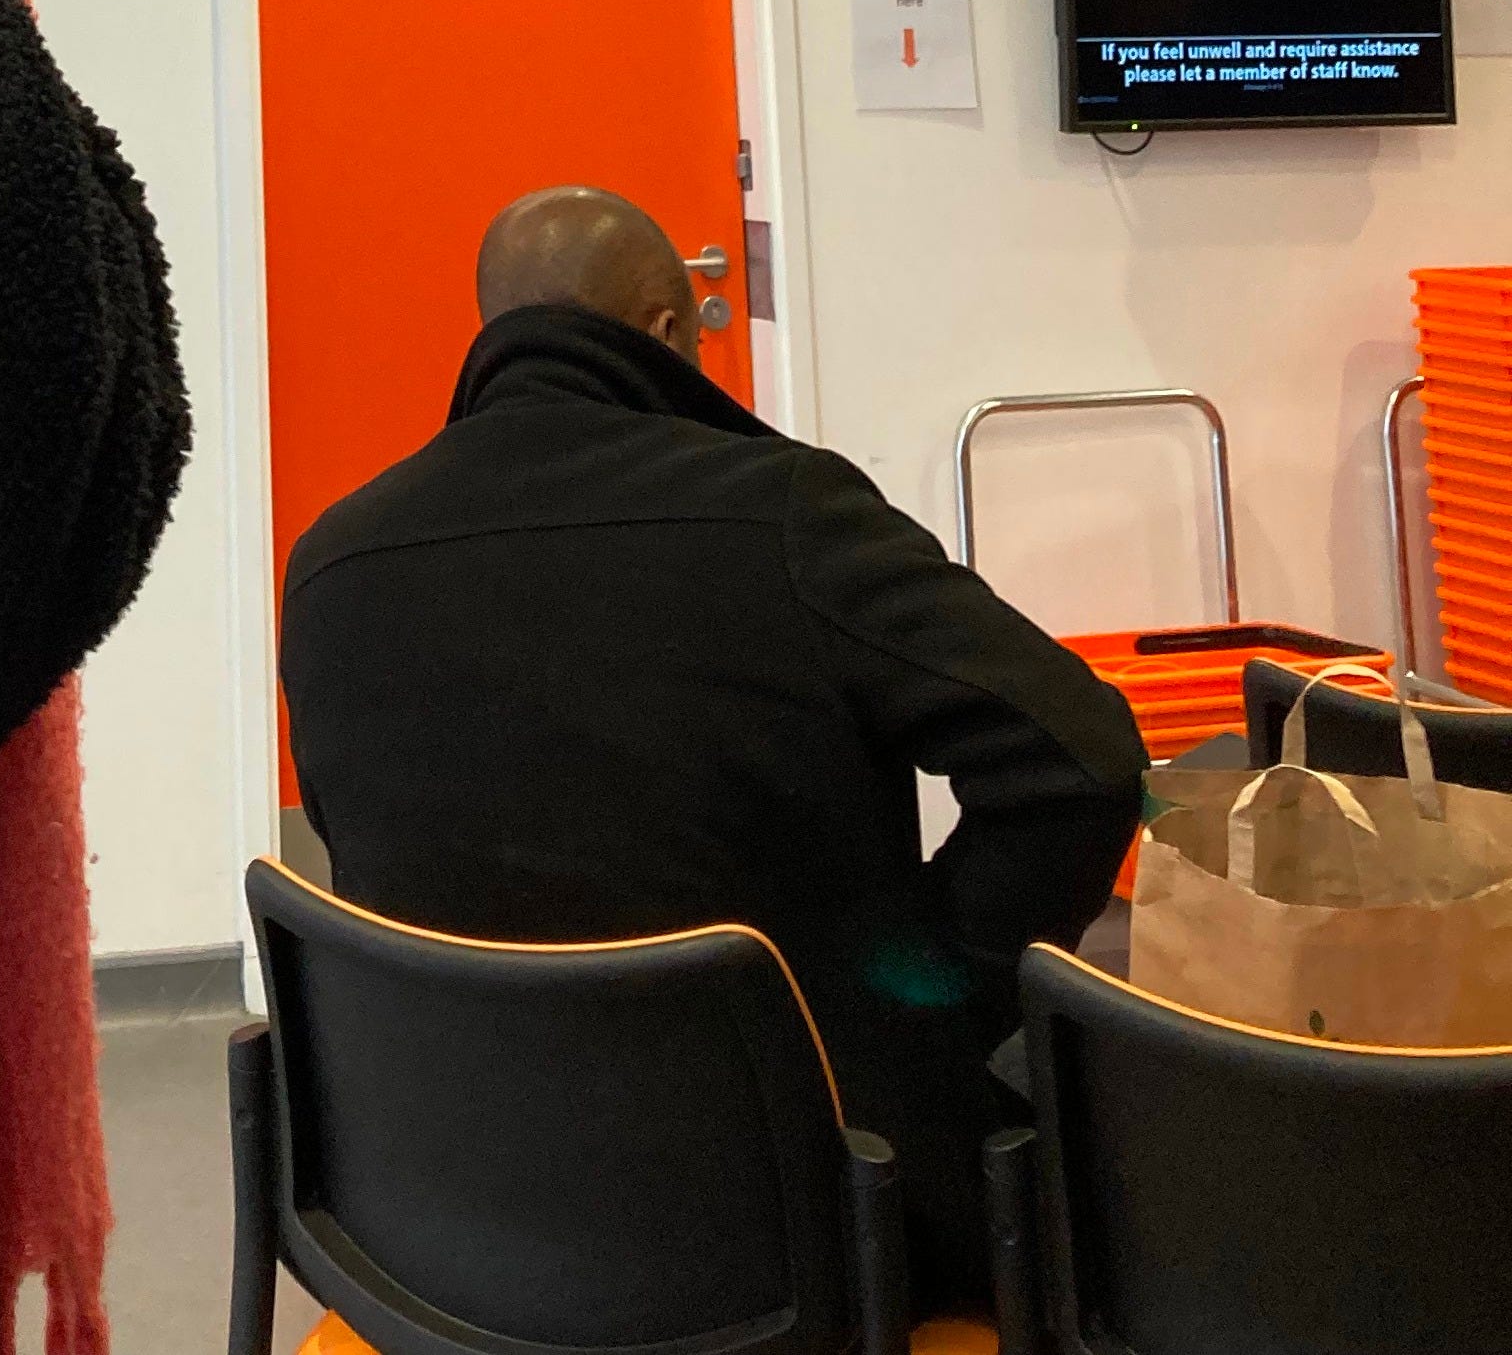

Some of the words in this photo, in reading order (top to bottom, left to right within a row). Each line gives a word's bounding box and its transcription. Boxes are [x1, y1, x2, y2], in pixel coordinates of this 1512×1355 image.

[1102, 43, 1115, 60] If
[1118, 47, 1149, 65] you
[1154, 42, 1184, 60] feel
[1188, 41, 1241, 59] unwell
[1245, 41, 1275, 58] and
[1279, 40, 1337, 62] require
[1340, 39, 1419, 56] assistance
[1124, 65, 1176, 87] please
[1180, 63, 1202, 81] let
[1205, 68, 1215, 81] a
[1219, 62, 1287, 80] member
[1290, 61, 1308, 79] of
[1311, 61, 1348, 79] staff
[1351, 61, 1400, 78] know.
